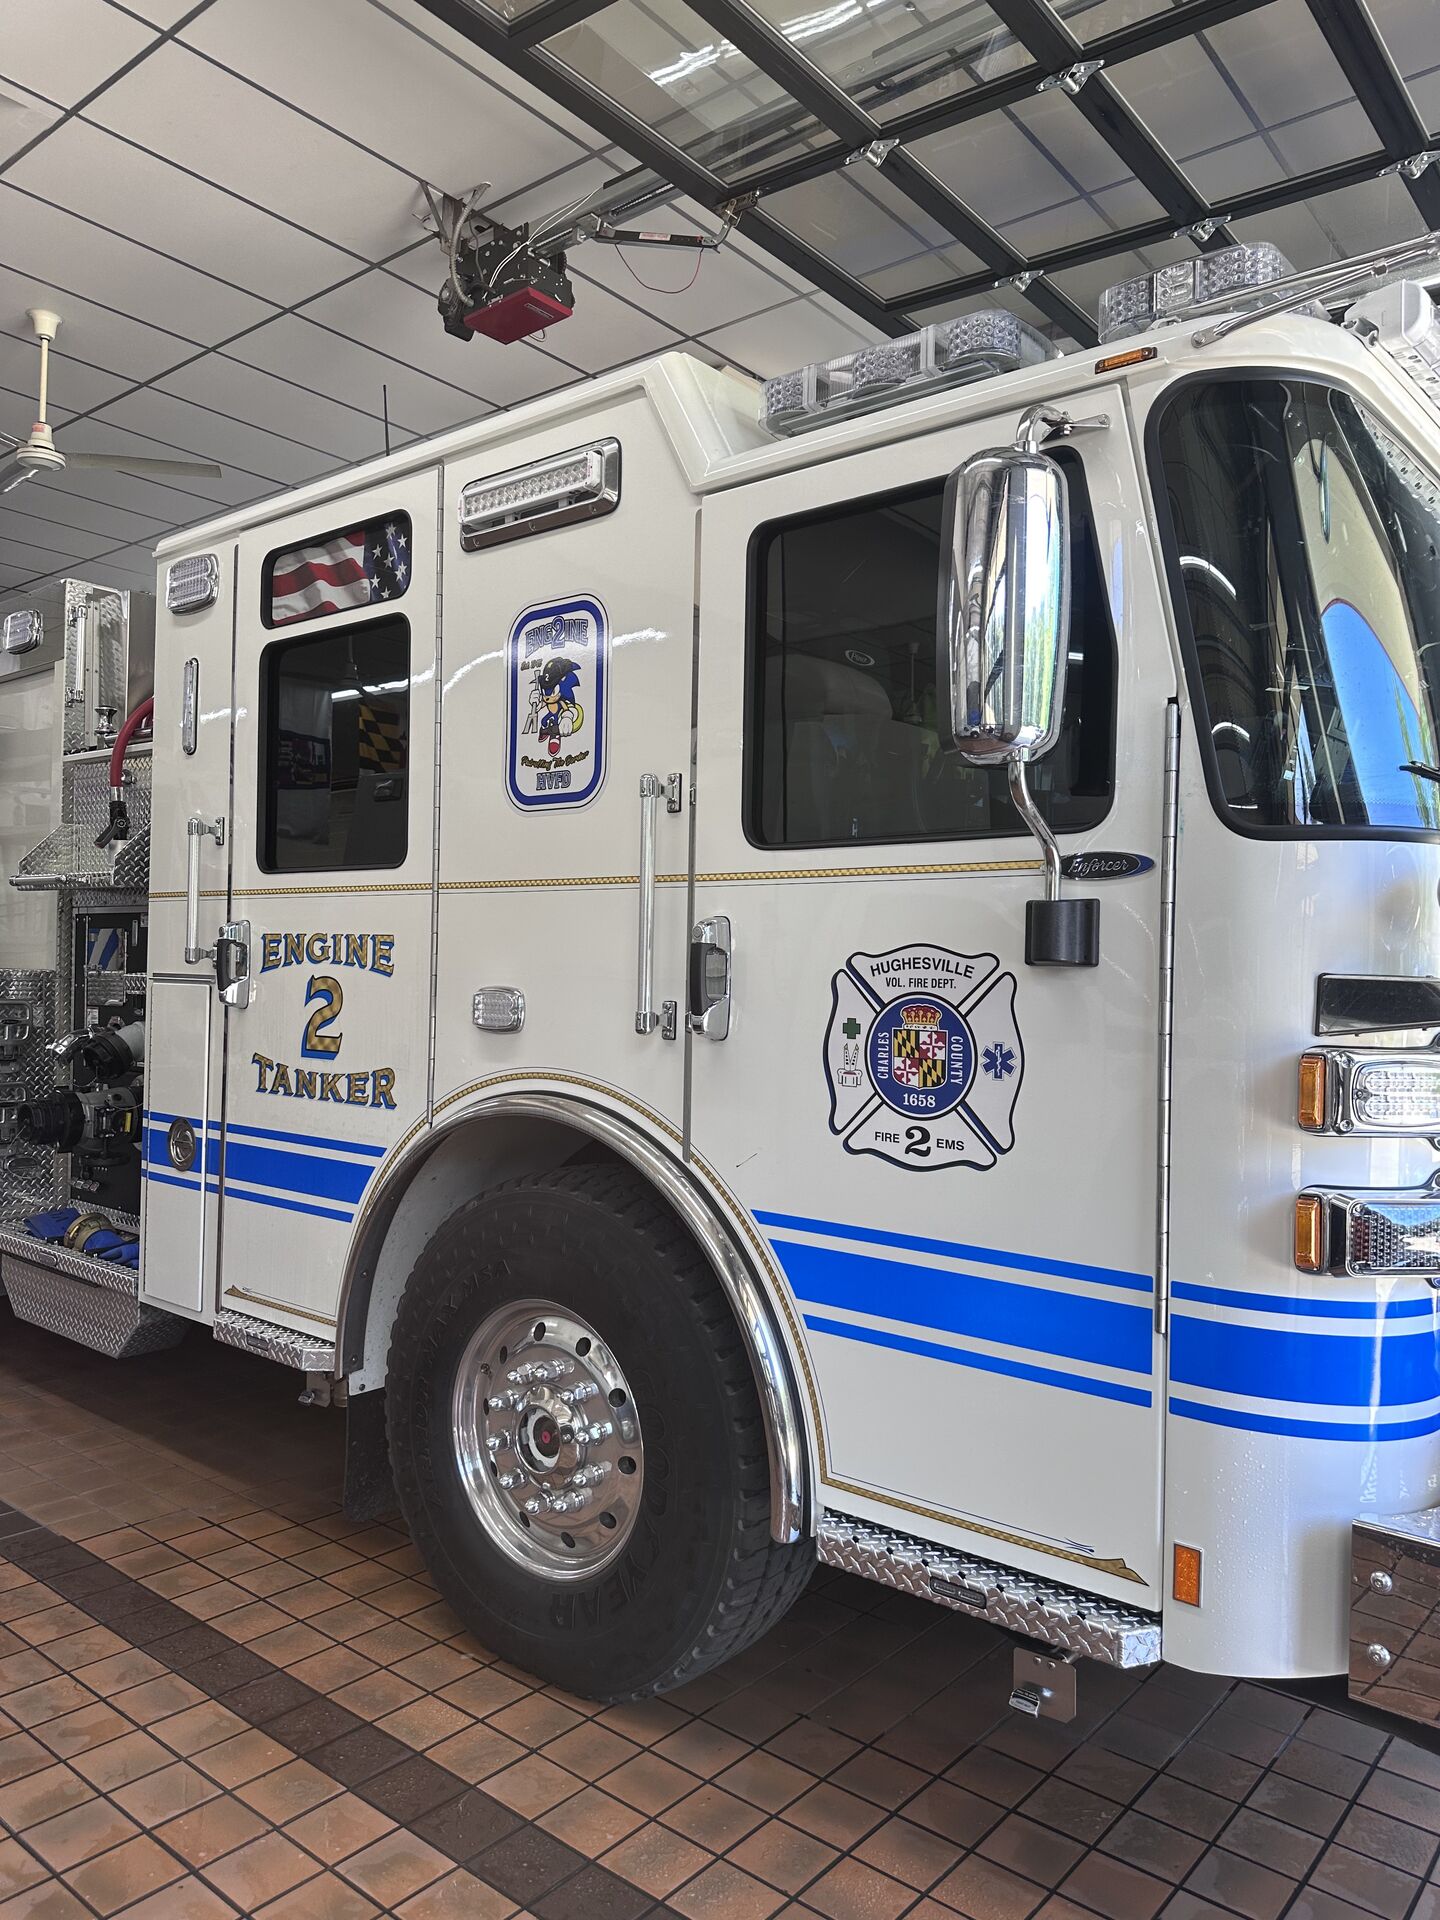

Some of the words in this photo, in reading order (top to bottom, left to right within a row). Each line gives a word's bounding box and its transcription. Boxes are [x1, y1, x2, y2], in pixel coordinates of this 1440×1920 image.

[536, 770, 572, 791] HVFD
[1067, 857, 1129, 877] Enforcer
[259, 932, 395, 978] ENGINE
[870, 956, 975, 979] HUGHESVILLE
[885, 977, 906, 988] VOL.
[908, 977, 929, 988] FIRE
[931, 978, 957, 989] DEPT.
[300, 974, 344, 1061] 2
[877, 1032, 890, 1079] CHARLES
[950, 1035, 964, 1085] COUNTY
[251, 1051, 398, 1110] TANKER
[903, 1093, 936, 1108] 1658
[874, 1131, 900, 1144] FIRE
[904, 1125, 932, 1158] 2
[936, 1138, 965, 1151] EMS
